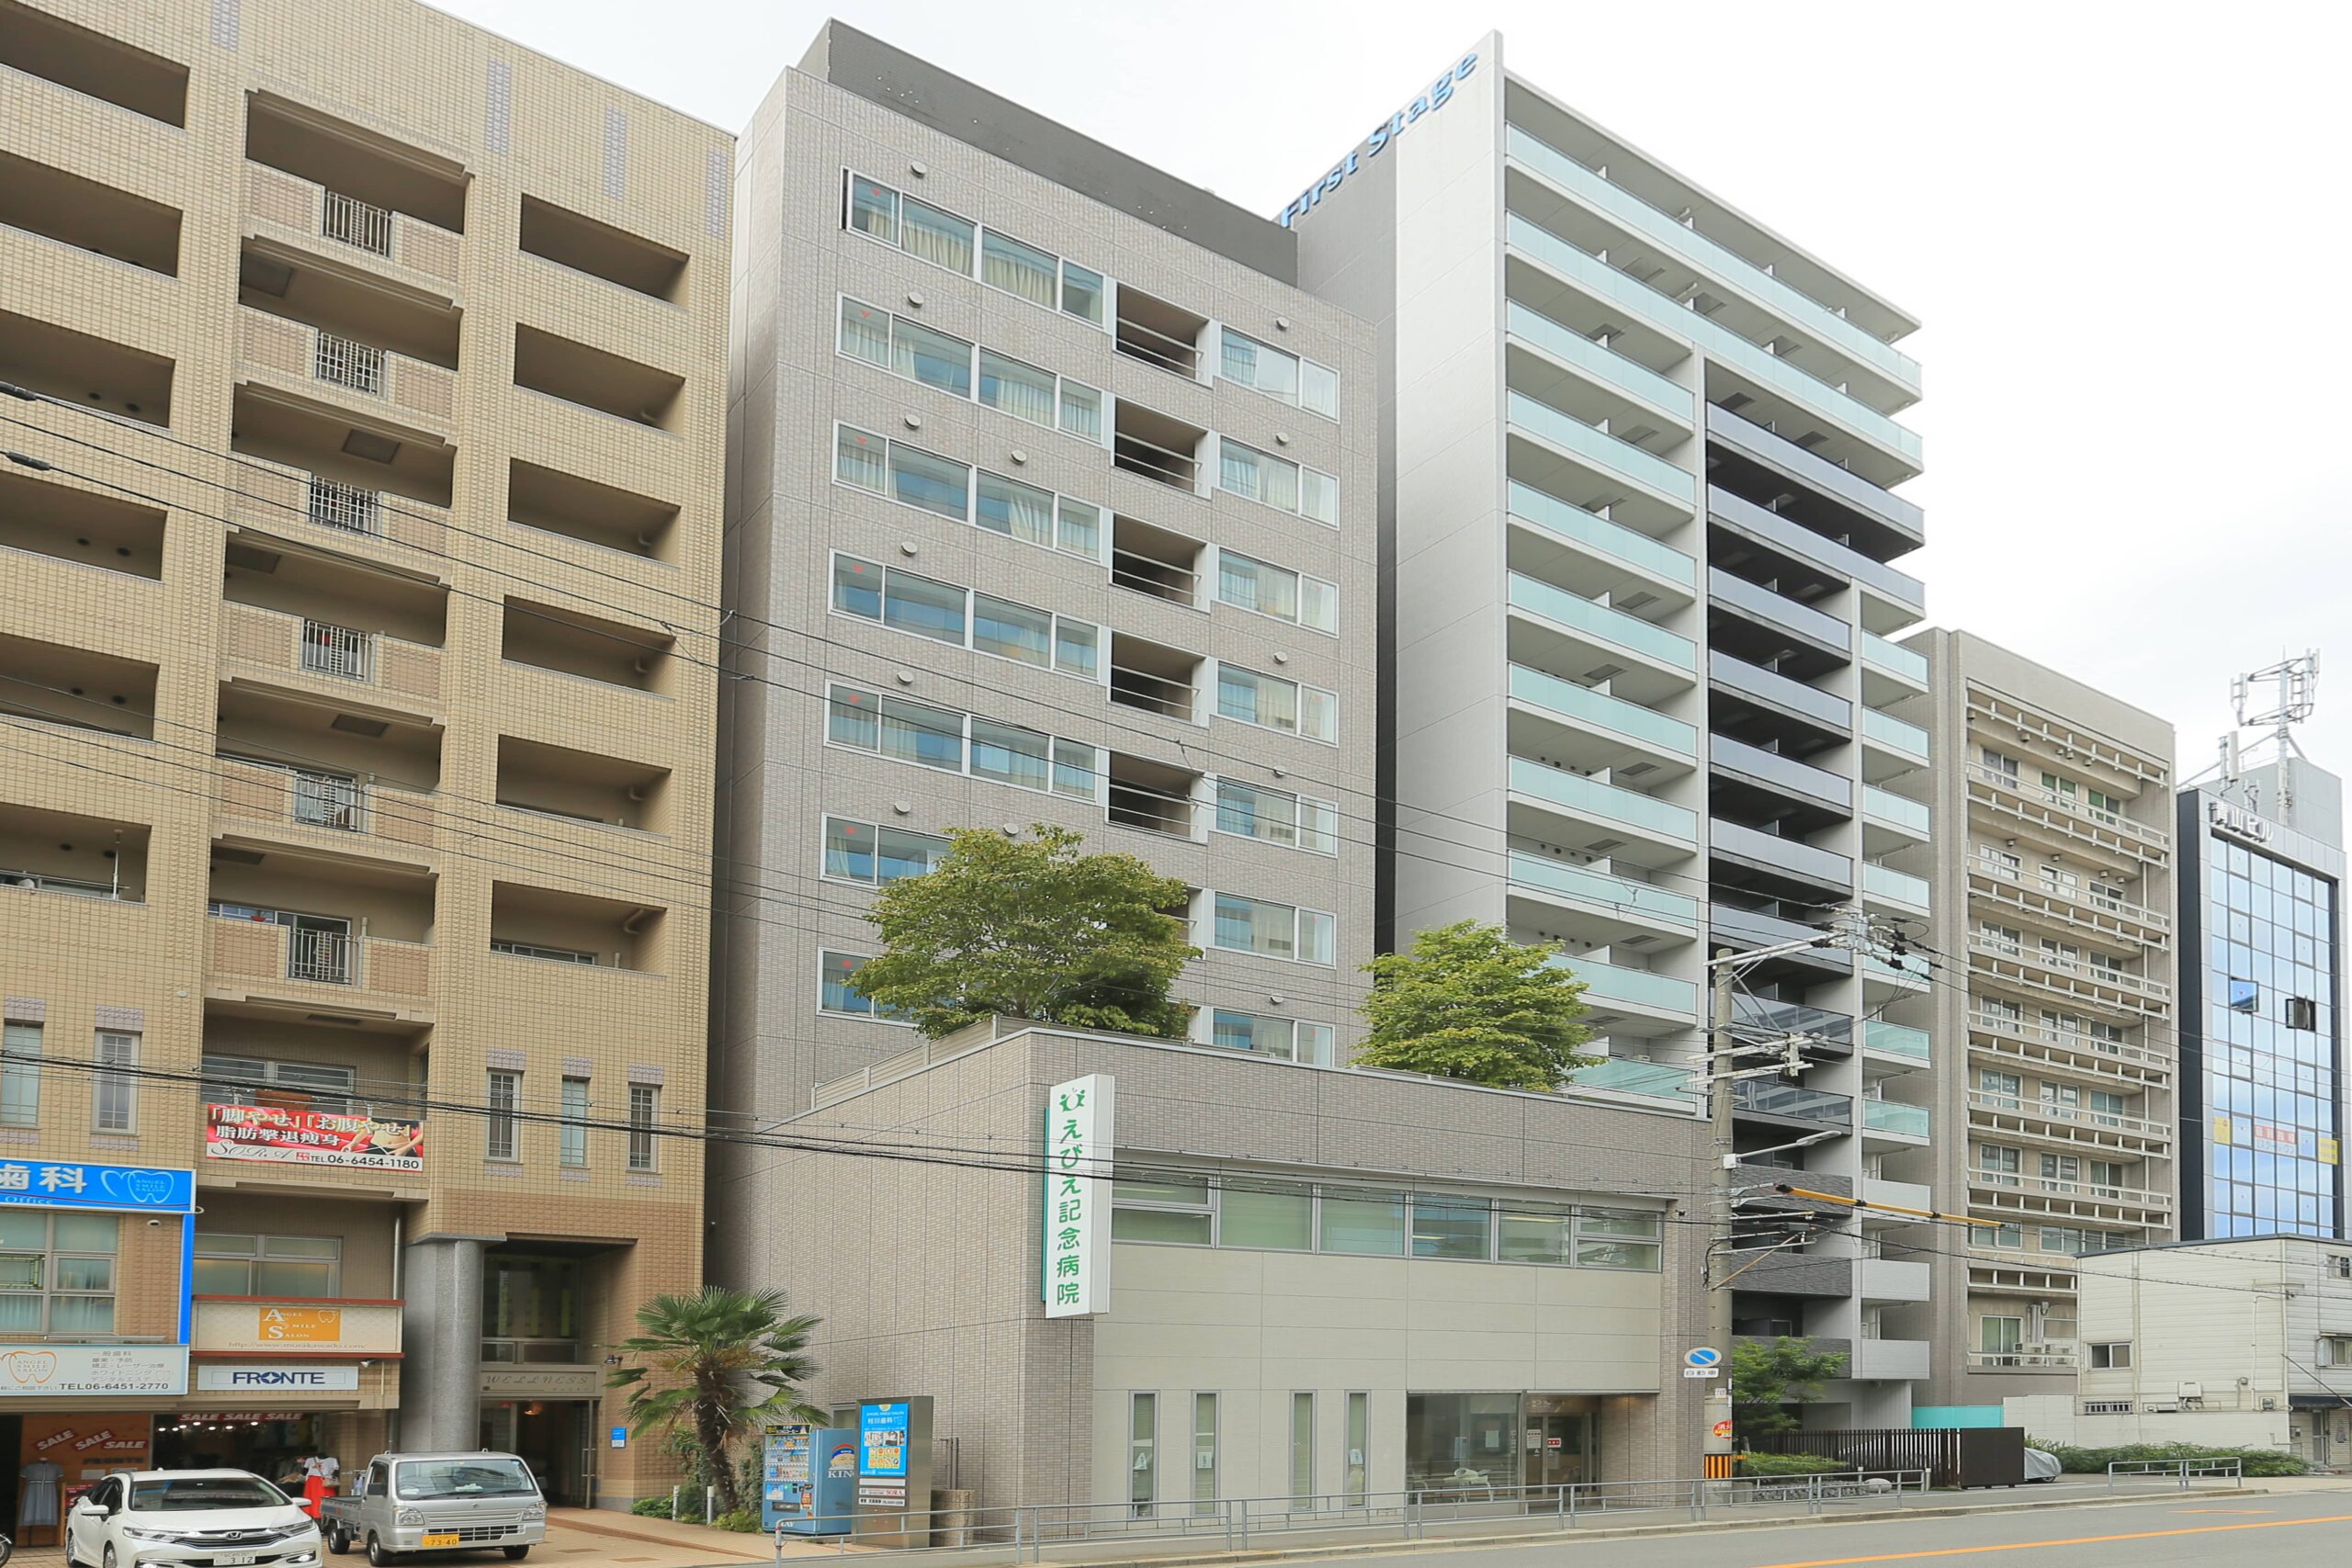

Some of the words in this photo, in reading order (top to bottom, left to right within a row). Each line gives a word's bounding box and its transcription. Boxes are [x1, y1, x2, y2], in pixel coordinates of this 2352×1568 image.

[1279, 151, 1359, 228] First
[1367, 52, 1478, 157] Stage
[1056, 1119, 1083, 1305] えびえ記念病院
[232, 1371, 325, 1385] FRONTE
[485, 1374, 589, 1384] WELLNESS
[179, 1413, 220, 1421] SALE
[222, 1413, 262, 1421] SALE
[265, 1412, 303, 1420] SALE
[37, 1429, 74, 1450] SALE
[74, 1429, 112, 1450] SALE
[103, 1440, 145, 1449] SALE
